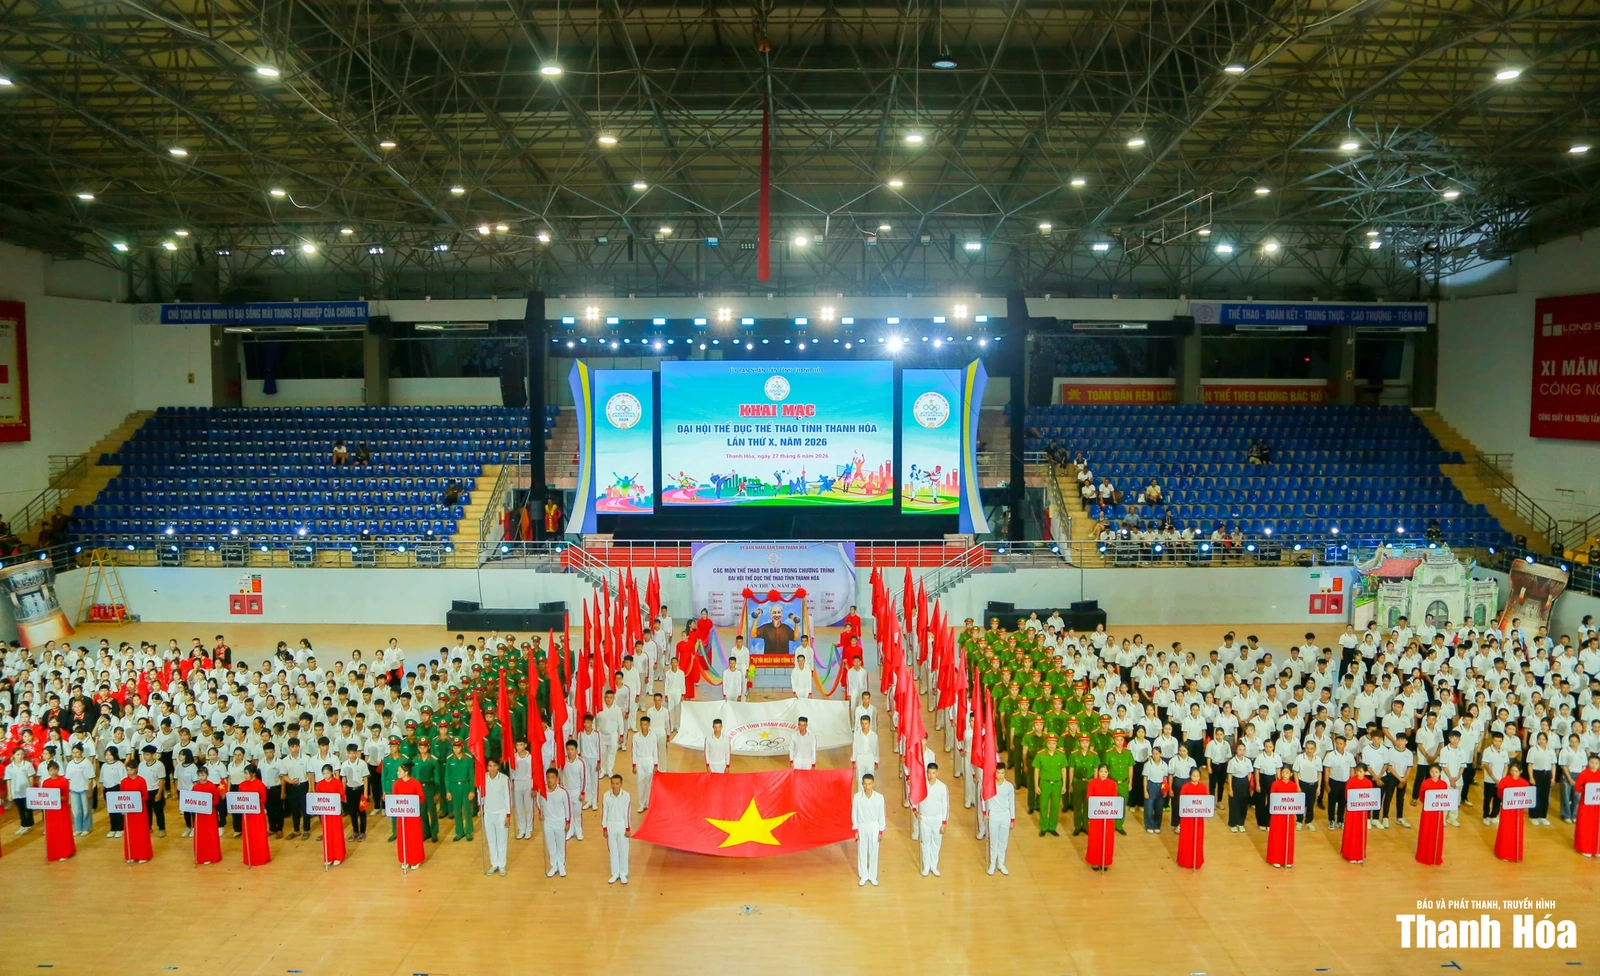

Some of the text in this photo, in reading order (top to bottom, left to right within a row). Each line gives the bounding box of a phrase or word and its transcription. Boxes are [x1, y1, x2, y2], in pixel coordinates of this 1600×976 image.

[246, 305, 260, 320] SỐNG
[274, 308, 292, 318] TRONG
[302, 306, 322, 320] NGHIỆP
[324, 304, 335, 318] CỦA
[336, 305, 356, 318] CHÚNG
[1228, 306, 1240, 320] THỂ
[1242, 309, 1260, 320] THAO
[1286, 306, 1298, 320] KẾT
[1304, 310, 1326, 321] TRUNG
[1328, 310, 1345, 323] THỰC
[1351, 310, 1364, 321] CAO
[1366, 310, 1392, 323] THƯỢNG
[1563, 323, 1591, 331] LONG
[1542, 356, 1600, 376] XI MĂN
[1088, 388, 1111, 401] TOÀN
[1114, 388, 1133, 401] DÂN
[1135, 388, 1154, 401] RÈN
[1156, 390, 1176, 401] LUY
[1214, 387, 1231, 401] THỂ
[1233, 391, 1255, 401] THEO
[1258, 390, 1288, 401] GƯƠNG
[1290, 389, 1307, 401] BÁC
[1540, 382, 1581, 395] CÔNG
[740, 404, 815, 420] KHAI MẠC
[677, 422, 877, 434] ĐẠI HỘI THỂ DỤC THỂ THAO TỈNH THANH HÓA
[748, 436, 766, 446] THỨ
[768, 438, 778, 447] X,
[780, 436, 802, 446] NĂM
[804, 438, 828, 446] 2026
